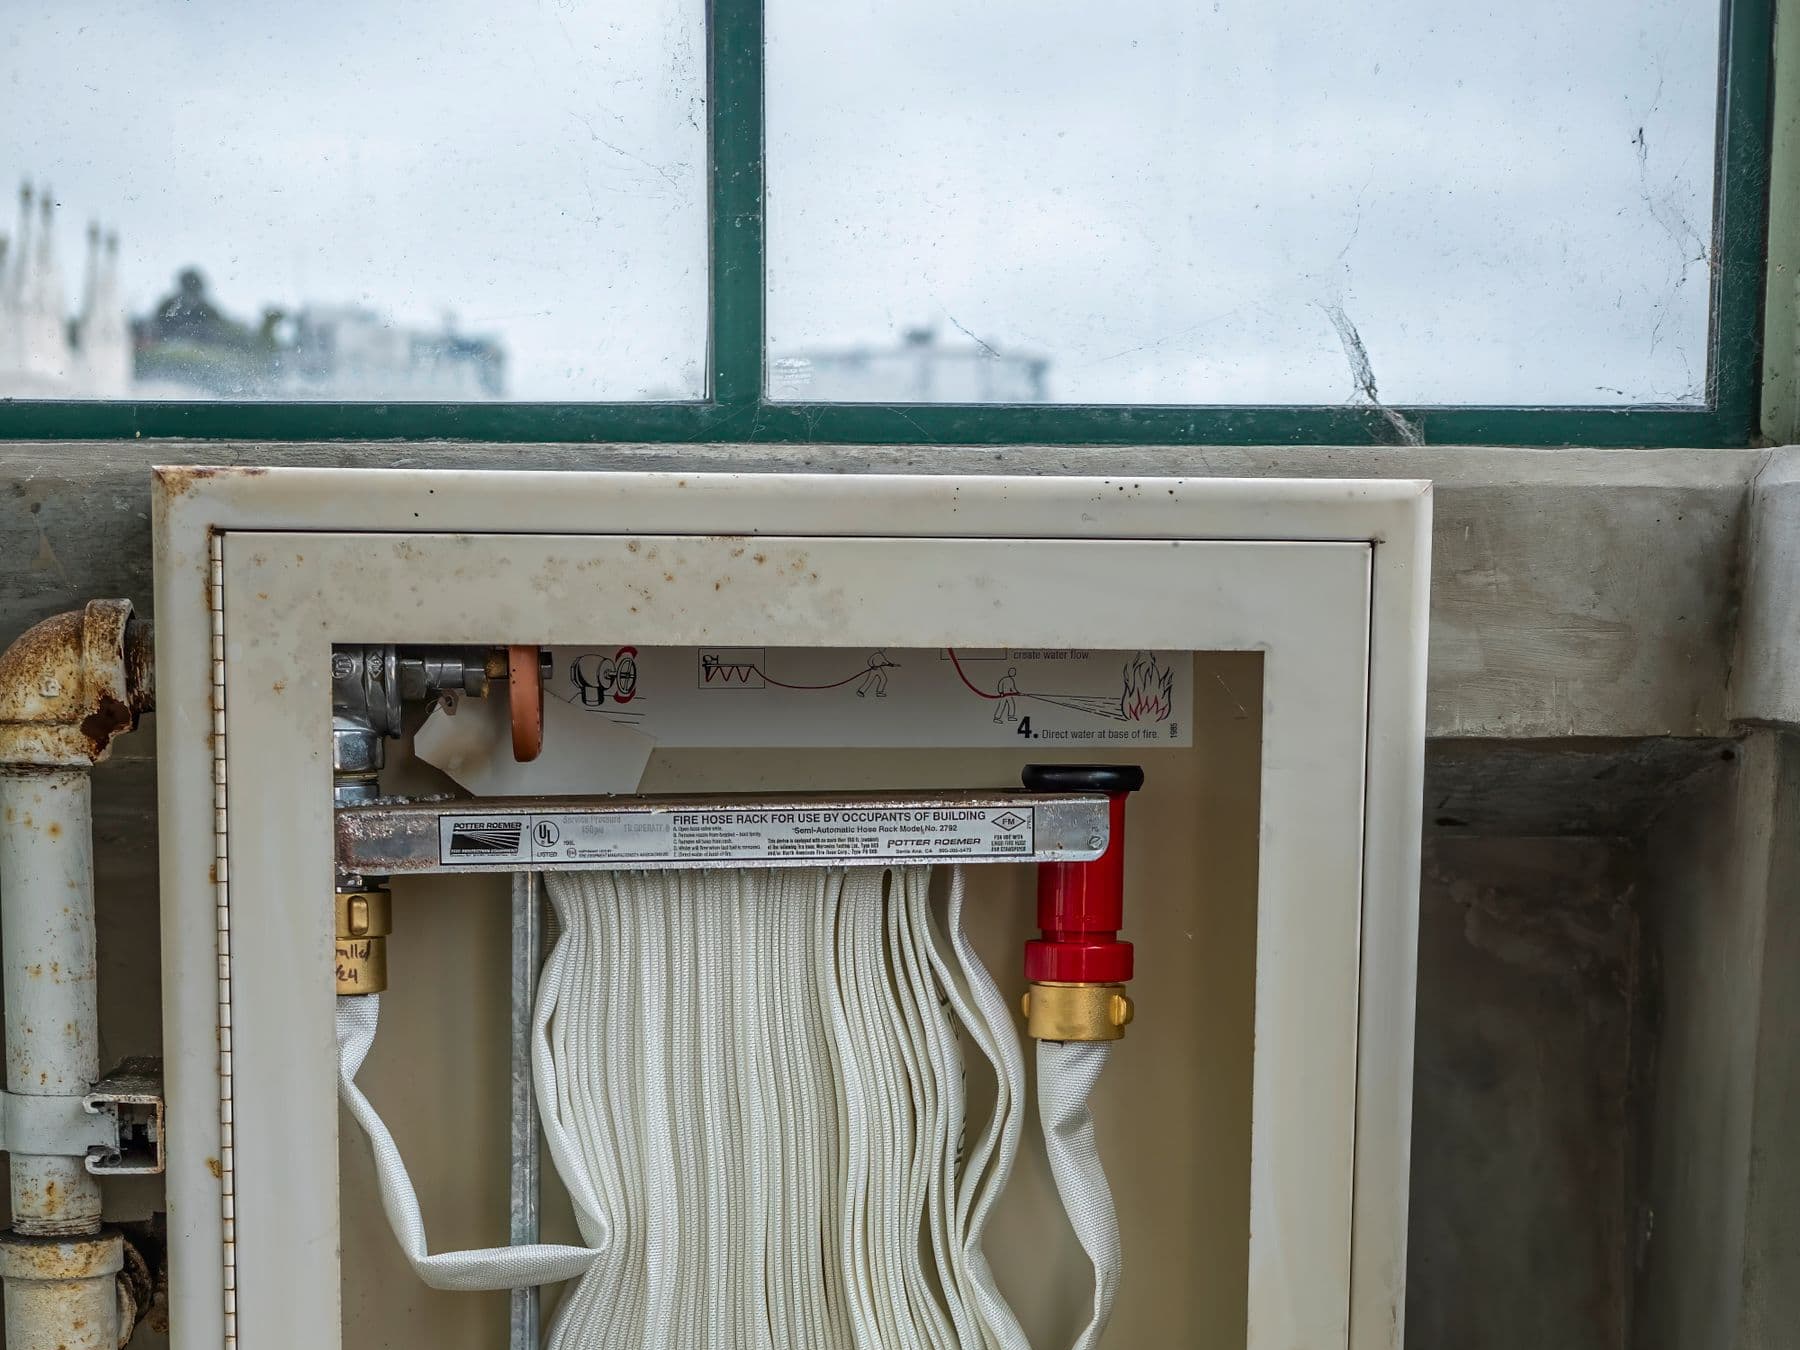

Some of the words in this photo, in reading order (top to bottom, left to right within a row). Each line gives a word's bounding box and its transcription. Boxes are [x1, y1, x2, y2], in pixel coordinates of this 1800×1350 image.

[1044, 650, 1067, 660] water
[1017, 716, 1038, 738] 4.
[1042, 729, 1068, 738] Direct
[1071, 730, 1095, 738] water
[1098, 730, 1106, 738] at
[1108, 729, 1129, 738] base
[1132, 729, 1140, 738] of
[1142, 729, 1160, 738] fire.
[673, 815, 698, 825] FIRE
[702, 814, 733, 824] HOSE
[737, 814, 768, 824] RACK
[771, 814, 794, 823] FOR
[798, 813, 820, 823] USE
[823, 813, 839, 822] BY
[842, 812, 911, 822] OCCUPANTS
[914, 812, 930, 821] OF
[933, 811, 986, 821] BUILDING
[539, 824, 554, 844] UL
[888, 839, 931, 848] POTTER
